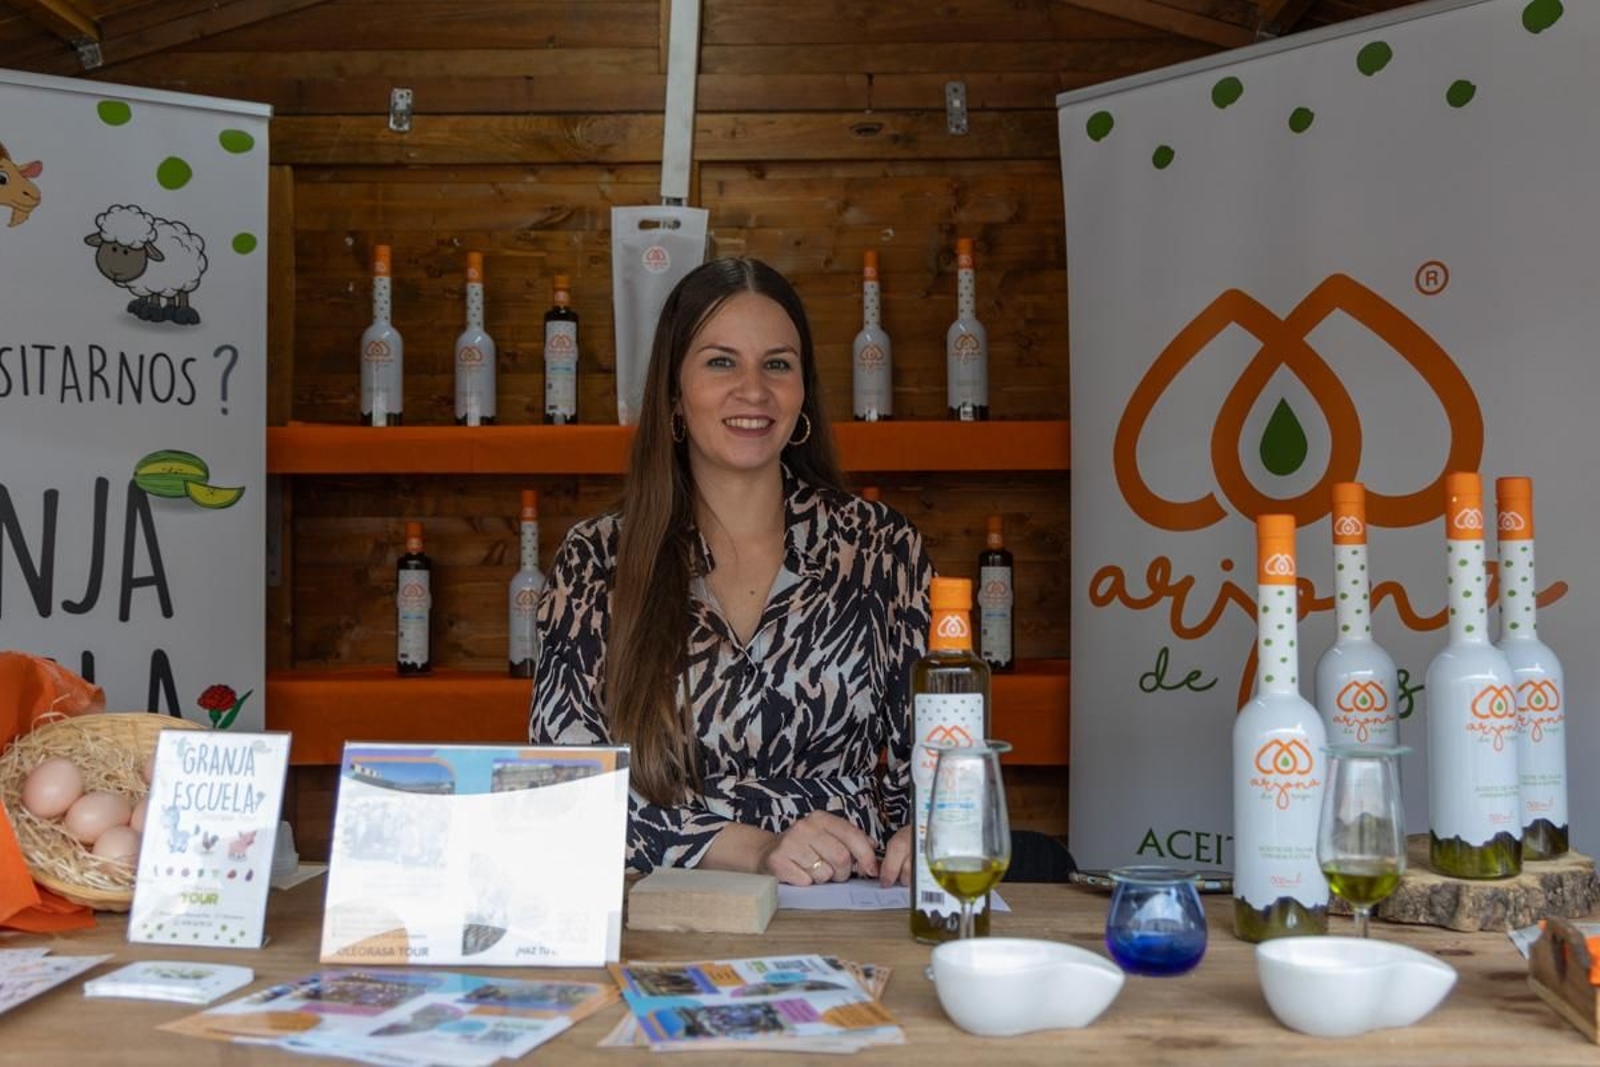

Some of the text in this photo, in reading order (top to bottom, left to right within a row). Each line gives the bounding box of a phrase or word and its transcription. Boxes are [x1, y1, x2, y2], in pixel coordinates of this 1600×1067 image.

[0, 344, 197, 406] SITARNOS
[1088, 555, 1569, 716] arjon
[1139, 646, 1218, 693] de
[182, 743, 255, 777] GRANJA
[173, 781, 255, 814] ESCUELA
[1136, 827, 1234, 865] ACEI
